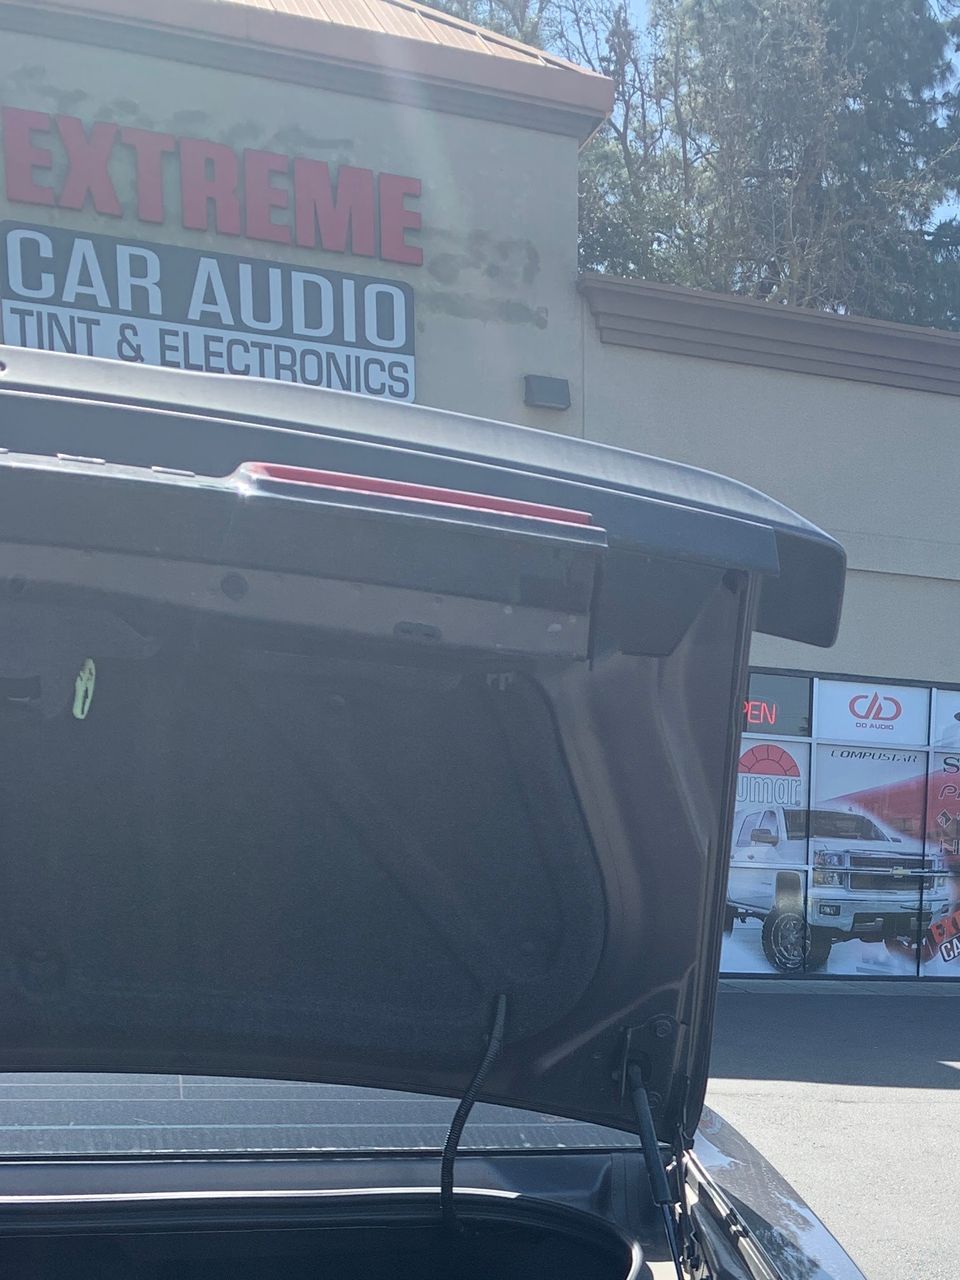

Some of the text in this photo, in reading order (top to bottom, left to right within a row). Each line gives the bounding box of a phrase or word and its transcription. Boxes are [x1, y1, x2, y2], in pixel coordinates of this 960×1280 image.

[2, 106, 424, 266] EXTREME
[6, 229, 407, 349] CAR AUDIO
[10, 306, 410, 398] TINT & ELECTRONICS
[869, 723, 895, 731] AUDIO
